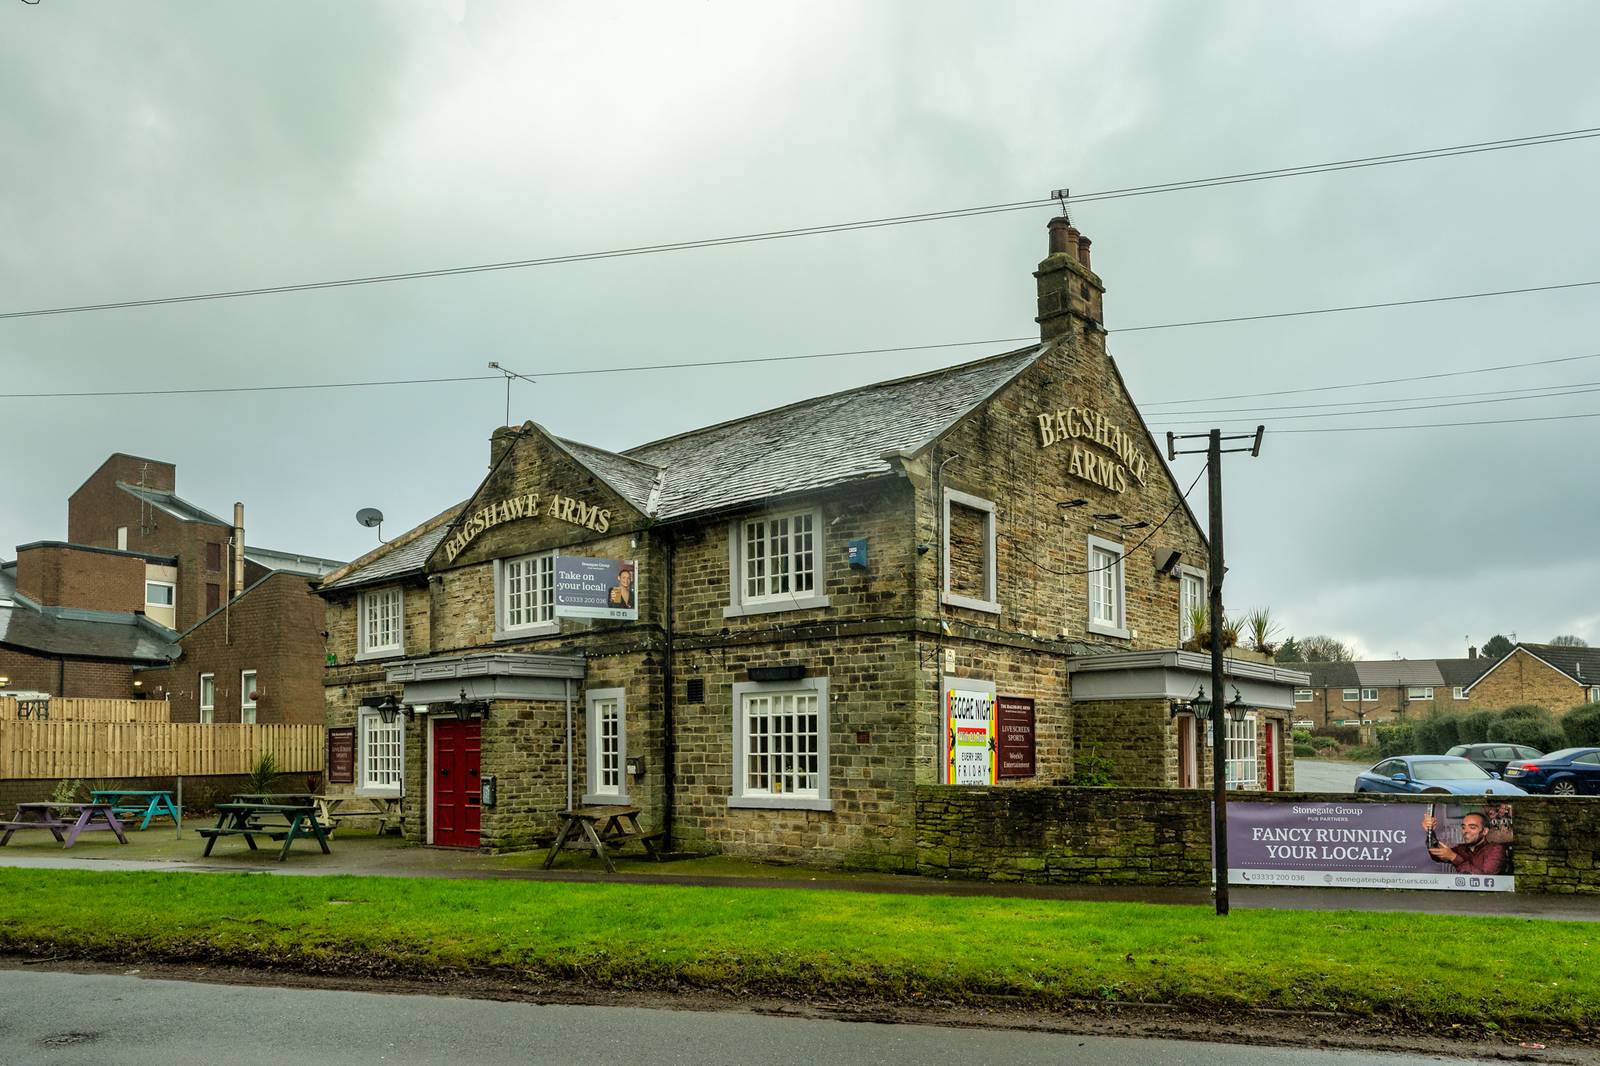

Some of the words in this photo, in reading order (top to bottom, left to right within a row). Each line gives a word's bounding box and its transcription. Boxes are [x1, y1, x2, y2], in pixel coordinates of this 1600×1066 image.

[1037, 407, 1149, 487] BAGSHAWE
[1068, 445, 1126, 494] ARMS
[444, 493, 539, 563] BAGSHAWE
[547, 495, 612, 534] ARMS
[559, 571, 581, 580] Take
[582, 573, 594, 581] on
[558, 582, 581, 591] your
[582, 582, 607, 592] local!
[950, 697, 974, 719] REGGAE
[975, 699, 995, 720] NIGHT
[1007, 734, 1025, 742] SPORTS
[961, 752, 974, 761] EVERY
[1009, 752, 1024, 760] Weekly
[958, 764, 987, 777] FRIDAY
[1292, 806, 1334, 815] Stonegate
[1335, 807, 1363, 816] Group
[1252, 827, 1315, 841] FANCY
[1316, 829, 1407, 844] RUNNING
[1265, 845, 1320, 860] YOUR
[1321, 847, 1393, 861] LOCAL?
[1335, 876, 1439, 886] stonegatepubpartners.co.uk
